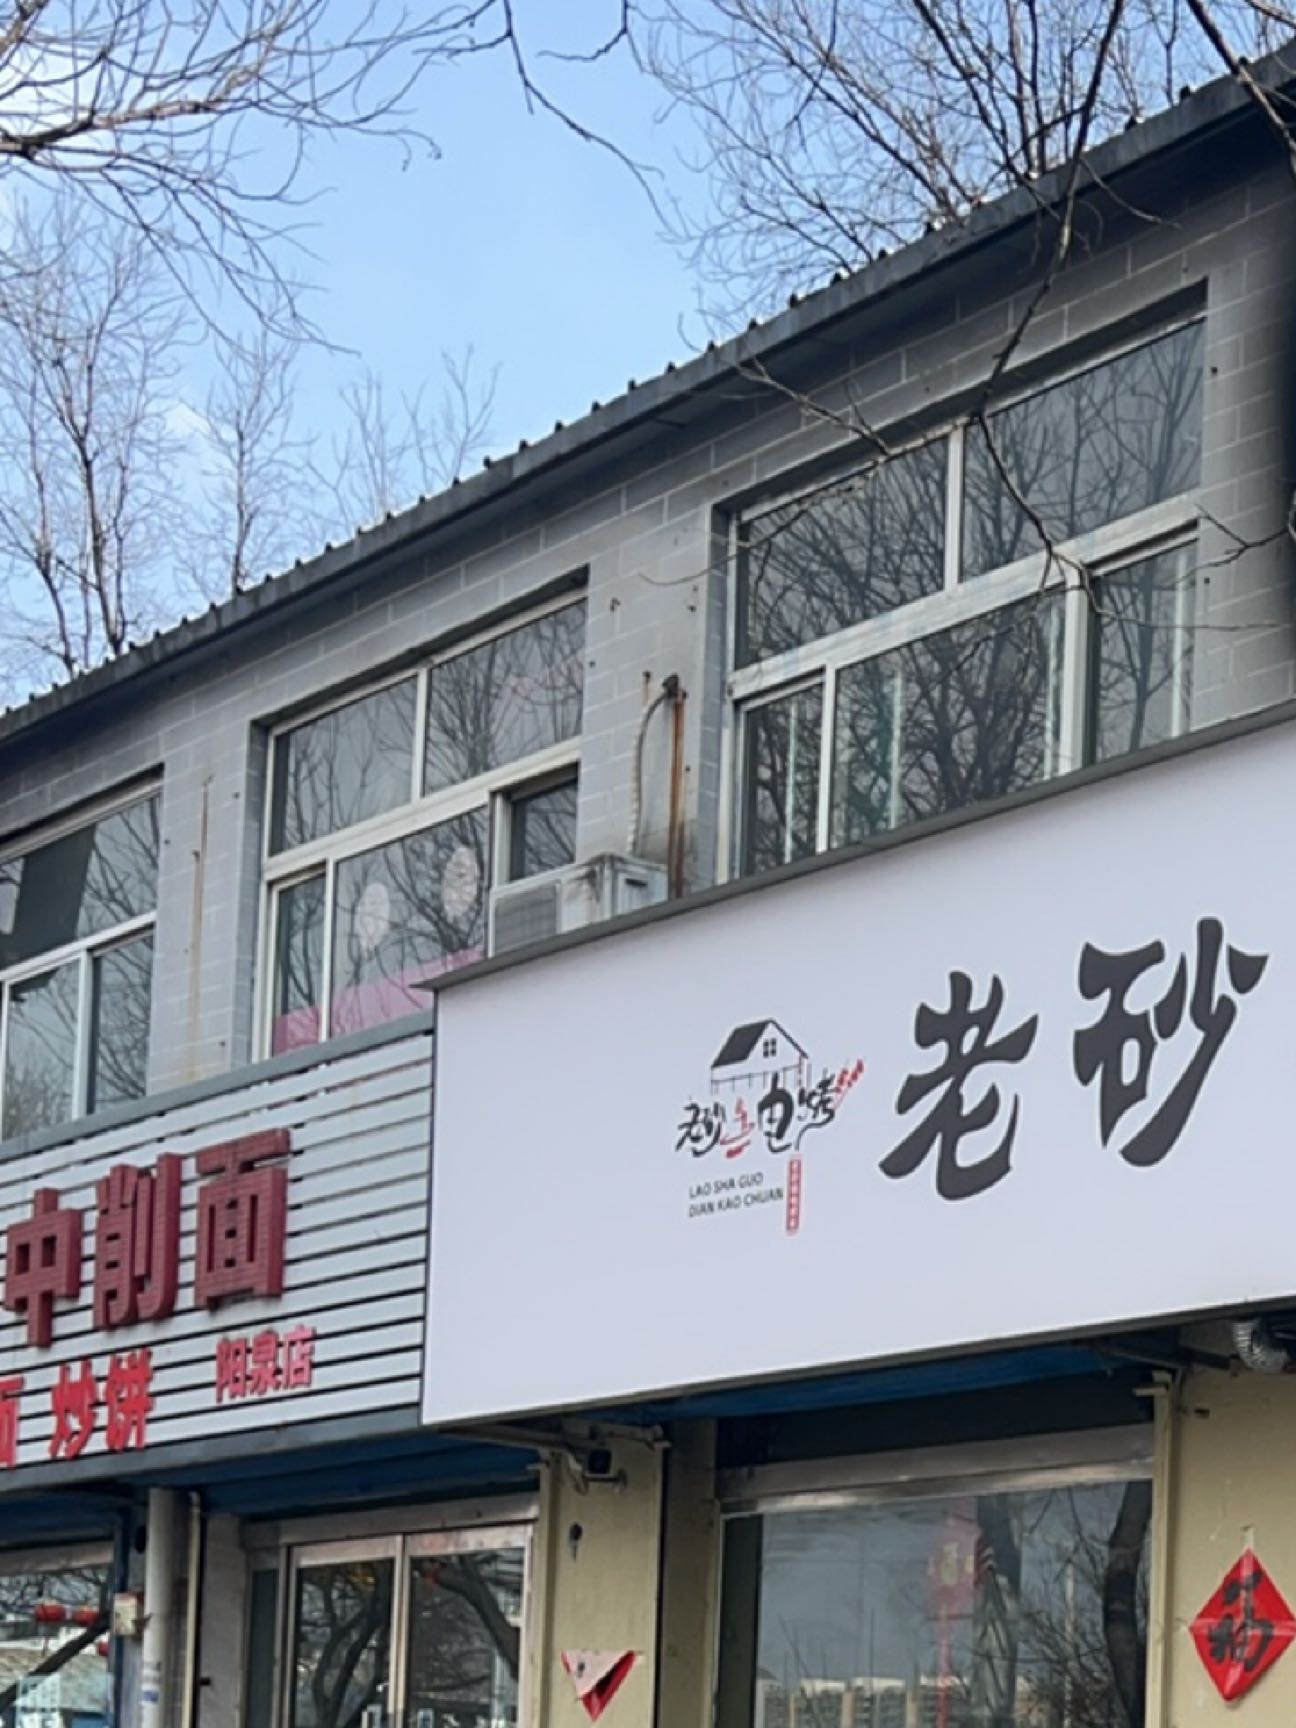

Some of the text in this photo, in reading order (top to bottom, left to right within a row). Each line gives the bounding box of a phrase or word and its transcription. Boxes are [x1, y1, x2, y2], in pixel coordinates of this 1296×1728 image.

[687, 1187, 785, 1217] DIAN KAO CHUAN
[688, 1171, 764, 1200] LAO SHA GUO
[215, 1325, 318, 1404] 阳泉店
[1207, 1571, 1275, 1672] 福
